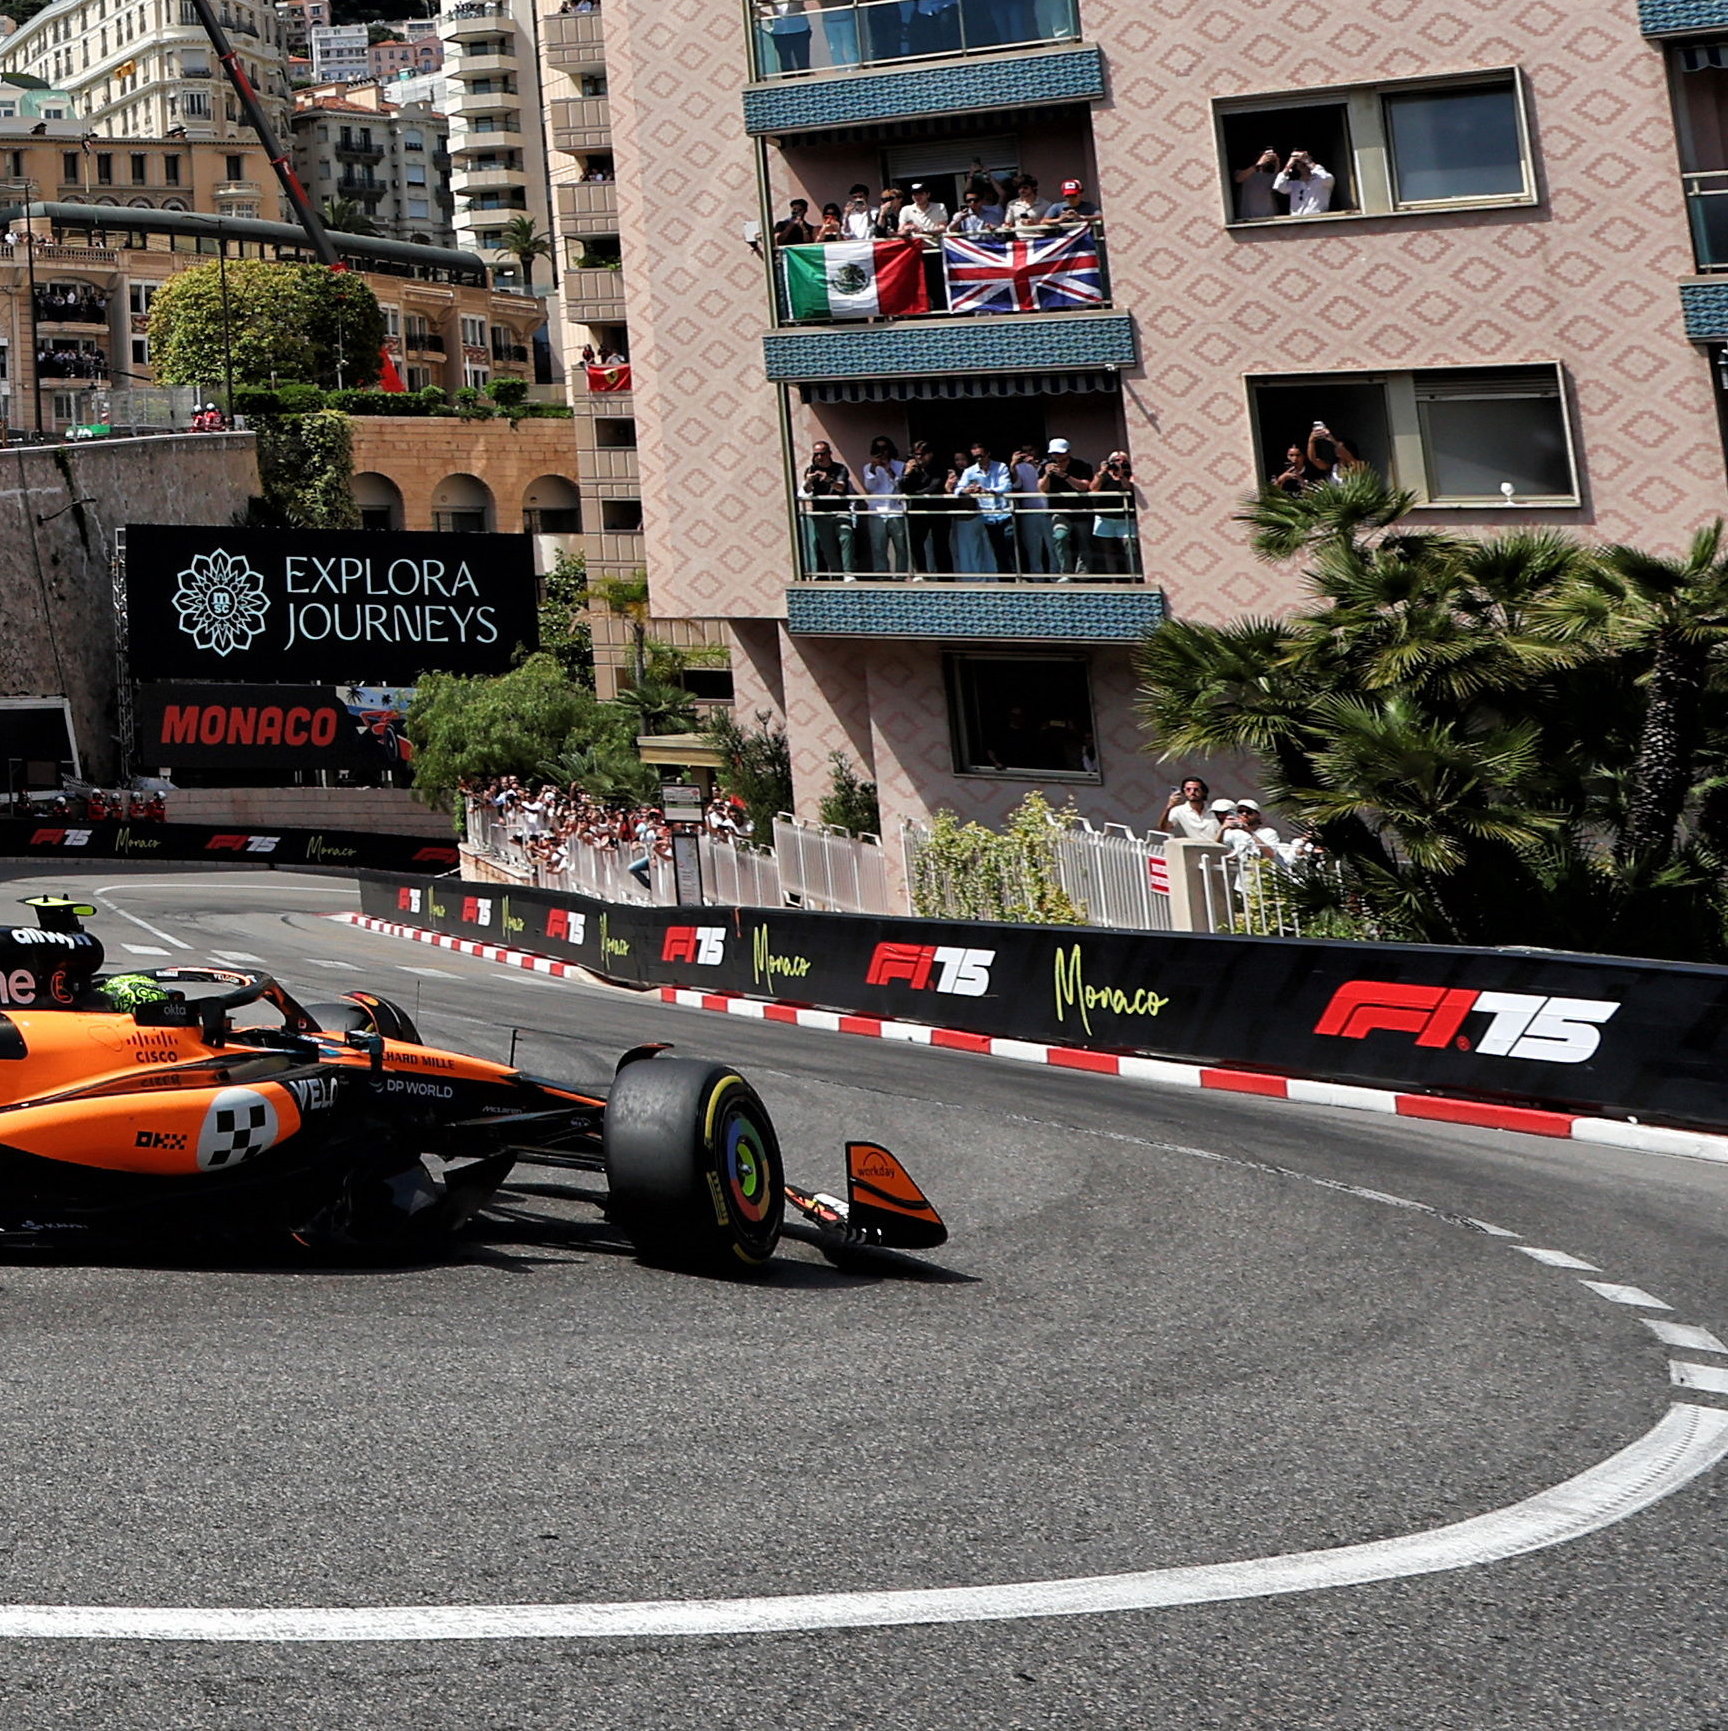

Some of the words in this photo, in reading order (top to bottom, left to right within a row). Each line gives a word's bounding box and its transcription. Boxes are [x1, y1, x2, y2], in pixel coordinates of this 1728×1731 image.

[286, 556, 480, 597] EXPLORA
[283, 602, 499, 651] JOURNEYS
[161, 705, 338, 747] MONACO
[29, 828, 66, 846] F1
[62, 829, 93, 846] 75
[115, 826, 163, 855] Monaco
[205, 834, 250, 851] F1
[246, 835, 281, 852] 75
[306, 835, 357, 862] Monaco
[461, 896, 479, 923] F1
[476, 898, 492, 926] 75
[12, 927, 93, 950] allwyn
[546, 908, 570, 940] F1
[567, 911, 586, 946] 75
[661, 926, 697, 963] F1
[695, 927, 727, 966] 75
[753, 922, 811, 995] Monaco
[864, 941, 938, 991] F1
[933, 946, 996, 997] 75
[1053, 943, 1170, 1037] Monaco
[163, 1003, 187, 1016] okta
[1313, 979, 1481, 1050] F1
[1471, 990, 1622, 1063] 75
[136, 1050, 178, 1063] CISCO
[383, 1052, 418, 1065] HARD
[422, 1055, 456, 1069] MILLE
[289, 1077, 339, 1112] VELO
[387, 1078, 404, 1092] DP
[405, 1080, 453, 1098] WORLD
[135, 1131, 188, 1151] OKX
[857, 1164, 896, 1179] workday
